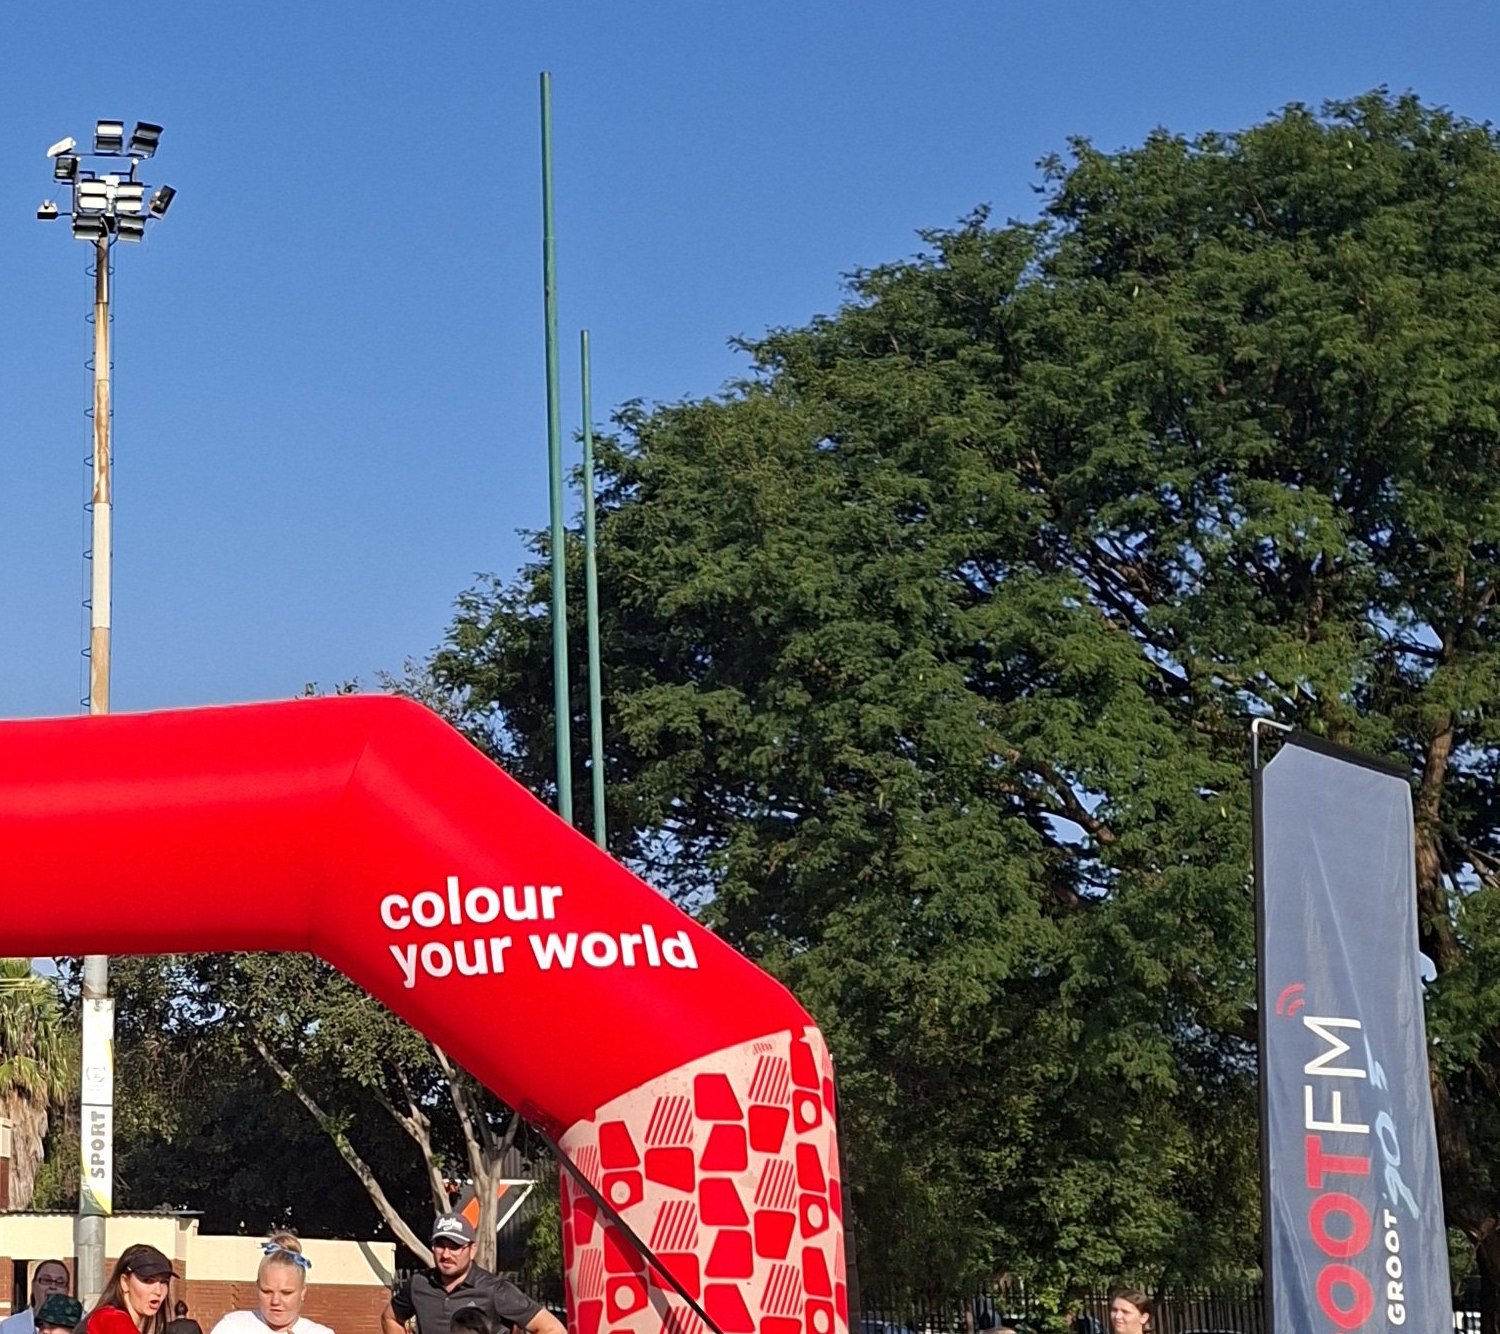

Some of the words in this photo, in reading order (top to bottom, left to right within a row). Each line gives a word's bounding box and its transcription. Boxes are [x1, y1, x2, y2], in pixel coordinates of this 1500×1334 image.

[380, 876, 563, 930] colour
[389, 934, 512, 988] your
[529, 924, 699, 969] world
[90, 1110, 106, 1179] SPORT
[1384, 1209, 1406, 1326] GROOT
